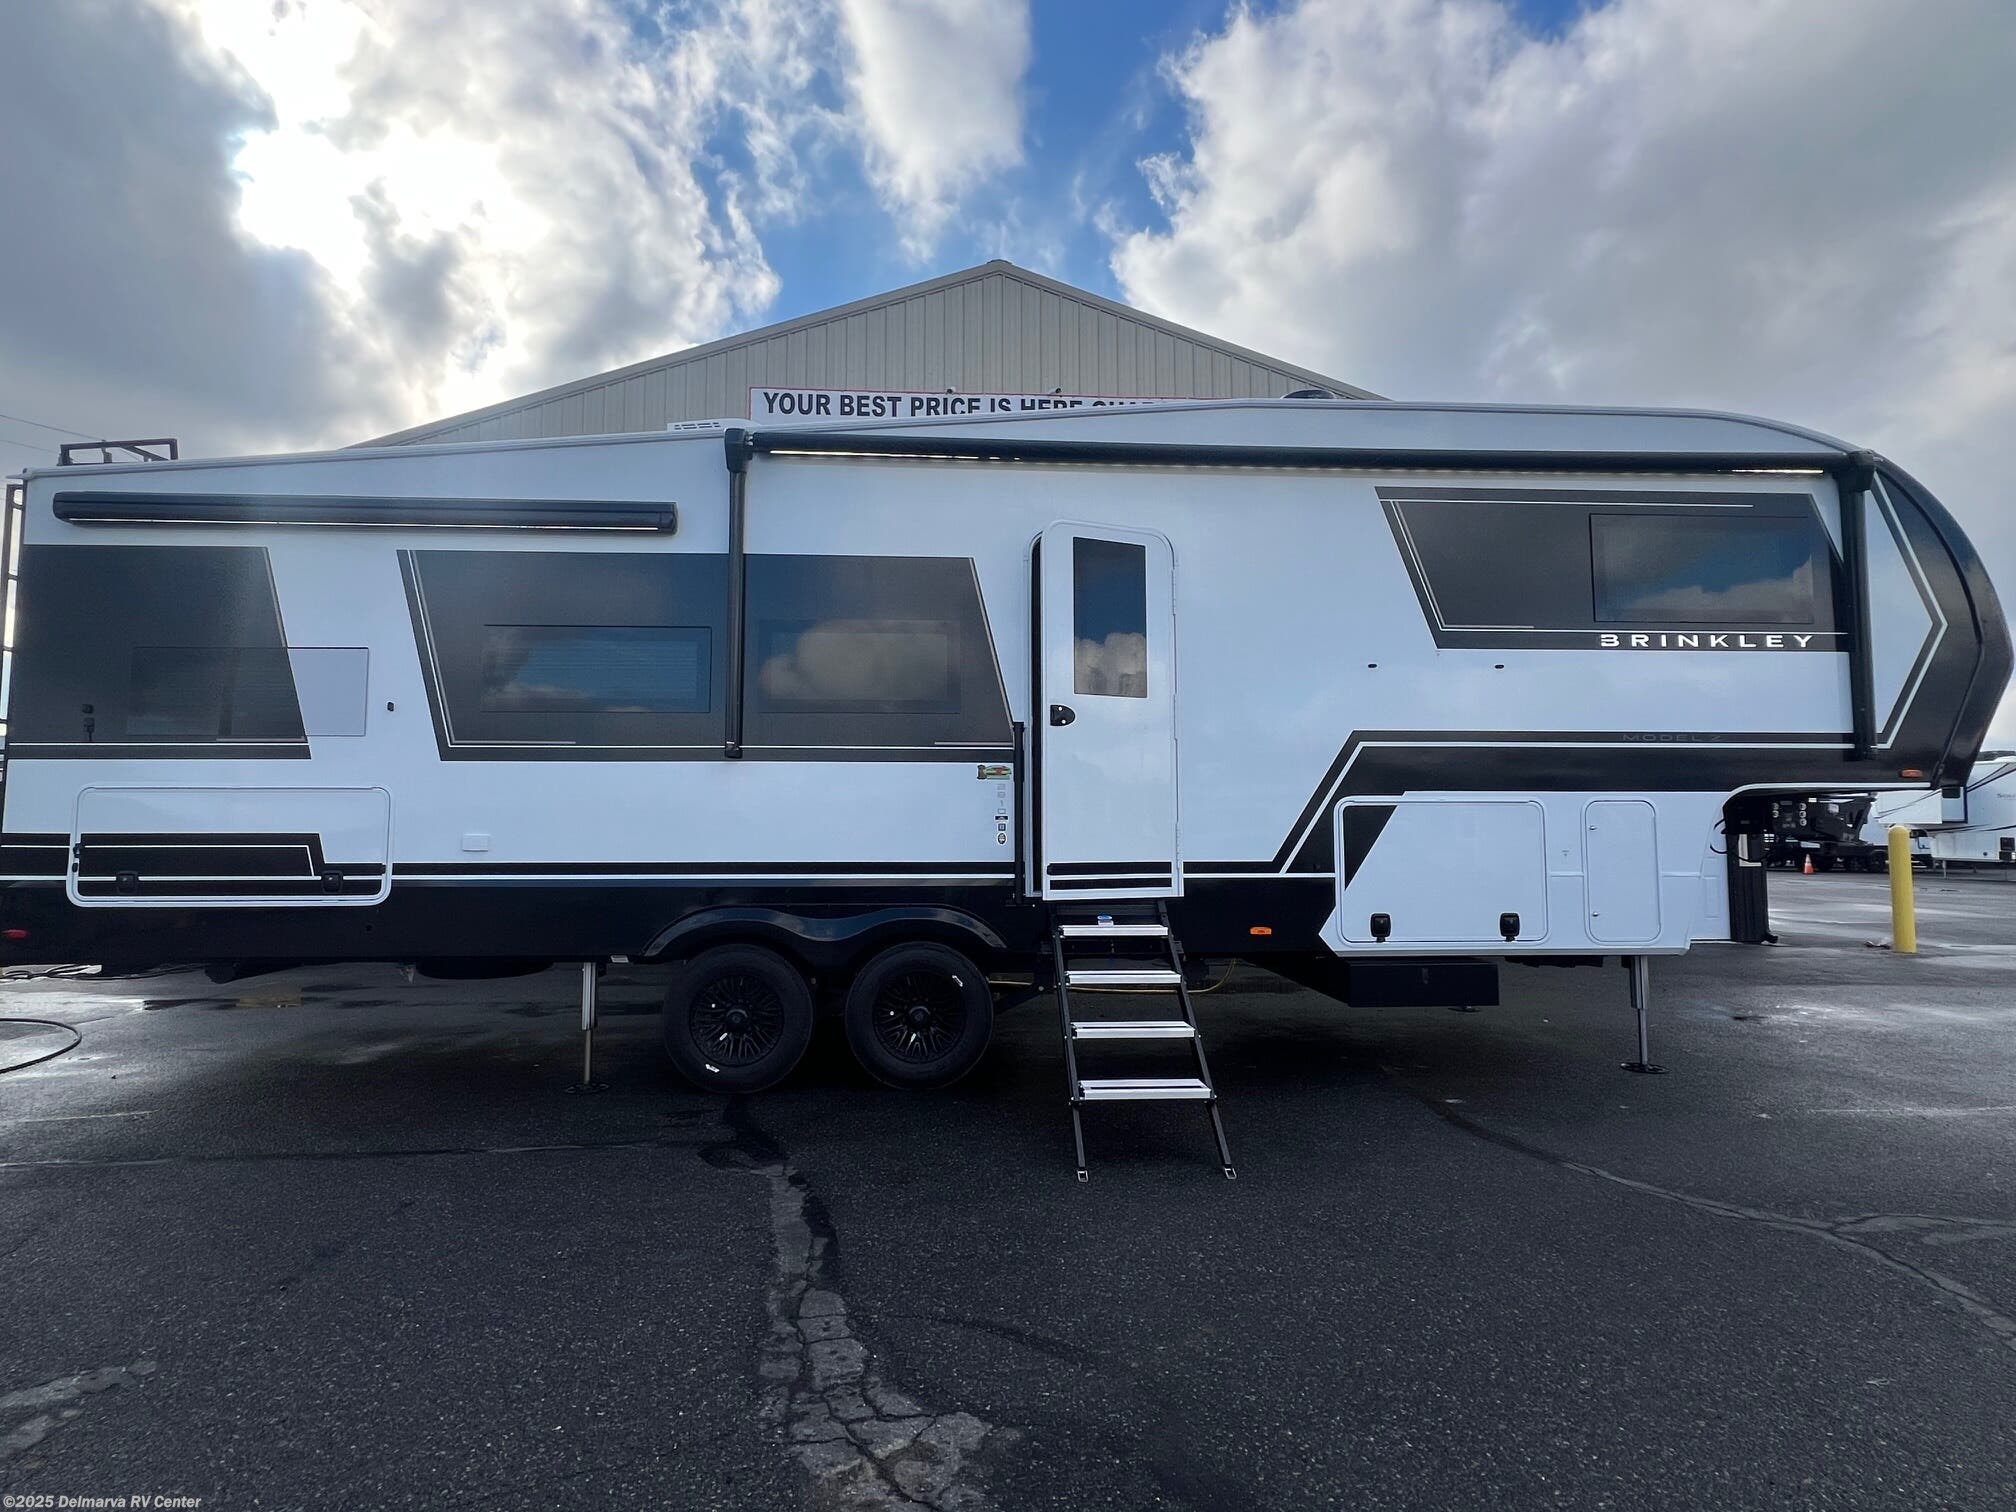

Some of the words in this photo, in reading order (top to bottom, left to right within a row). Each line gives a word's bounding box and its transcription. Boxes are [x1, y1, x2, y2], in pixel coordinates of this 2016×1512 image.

[763, 391, 831, 416] YOUR
[840, 394, 902, 417] BEST
[910, 396, 981, 417] PRICE
[990, 398, 1012, 413] IS
[1600, 633, 1813, 649] BRINKLEY
[1622, 733, 1701, 742] MODEL
